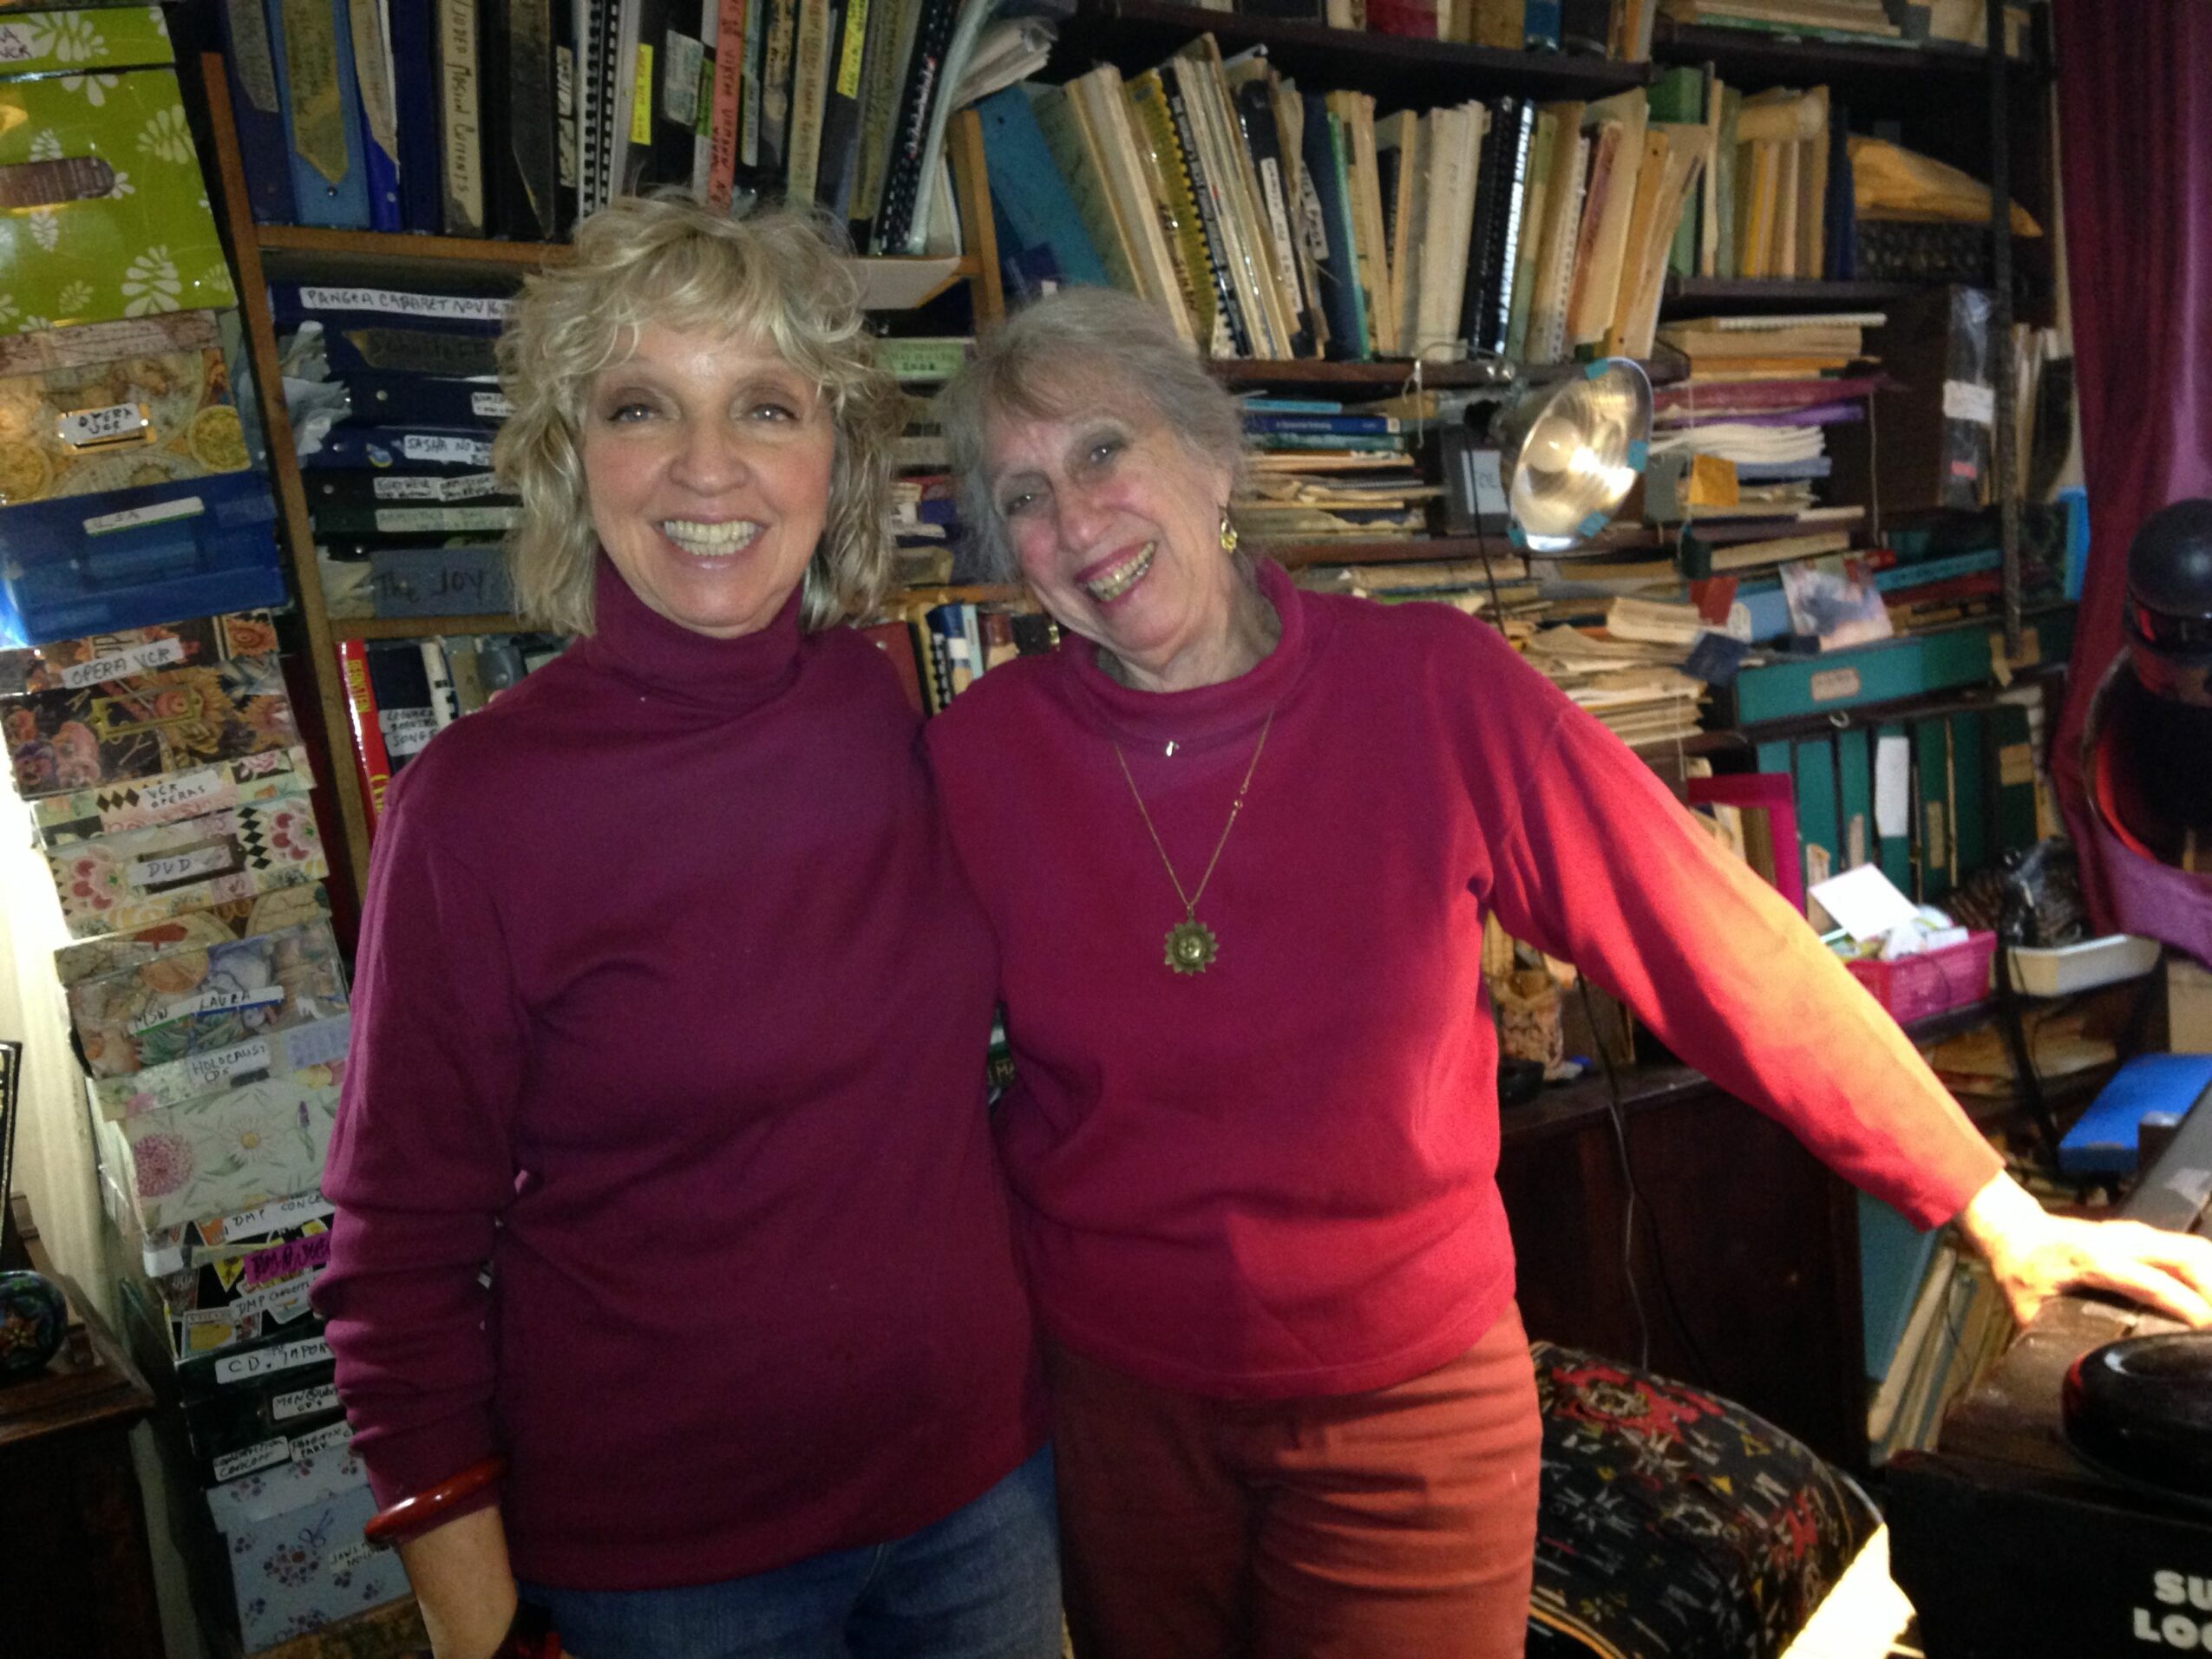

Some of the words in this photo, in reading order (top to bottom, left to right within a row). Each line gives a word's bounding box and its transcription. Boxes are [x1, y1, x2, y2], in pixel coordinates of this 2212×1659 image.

[71, 657, 128, 685] OPERA
[133, 648, 171, 668] VCR
[147, 783, 178, 799] VCR
[147, 859, 191, 878] DVD
[192, 1045, 265, 1074] HOLOCAUST
[236, 1295, 265, 1315] DMP
